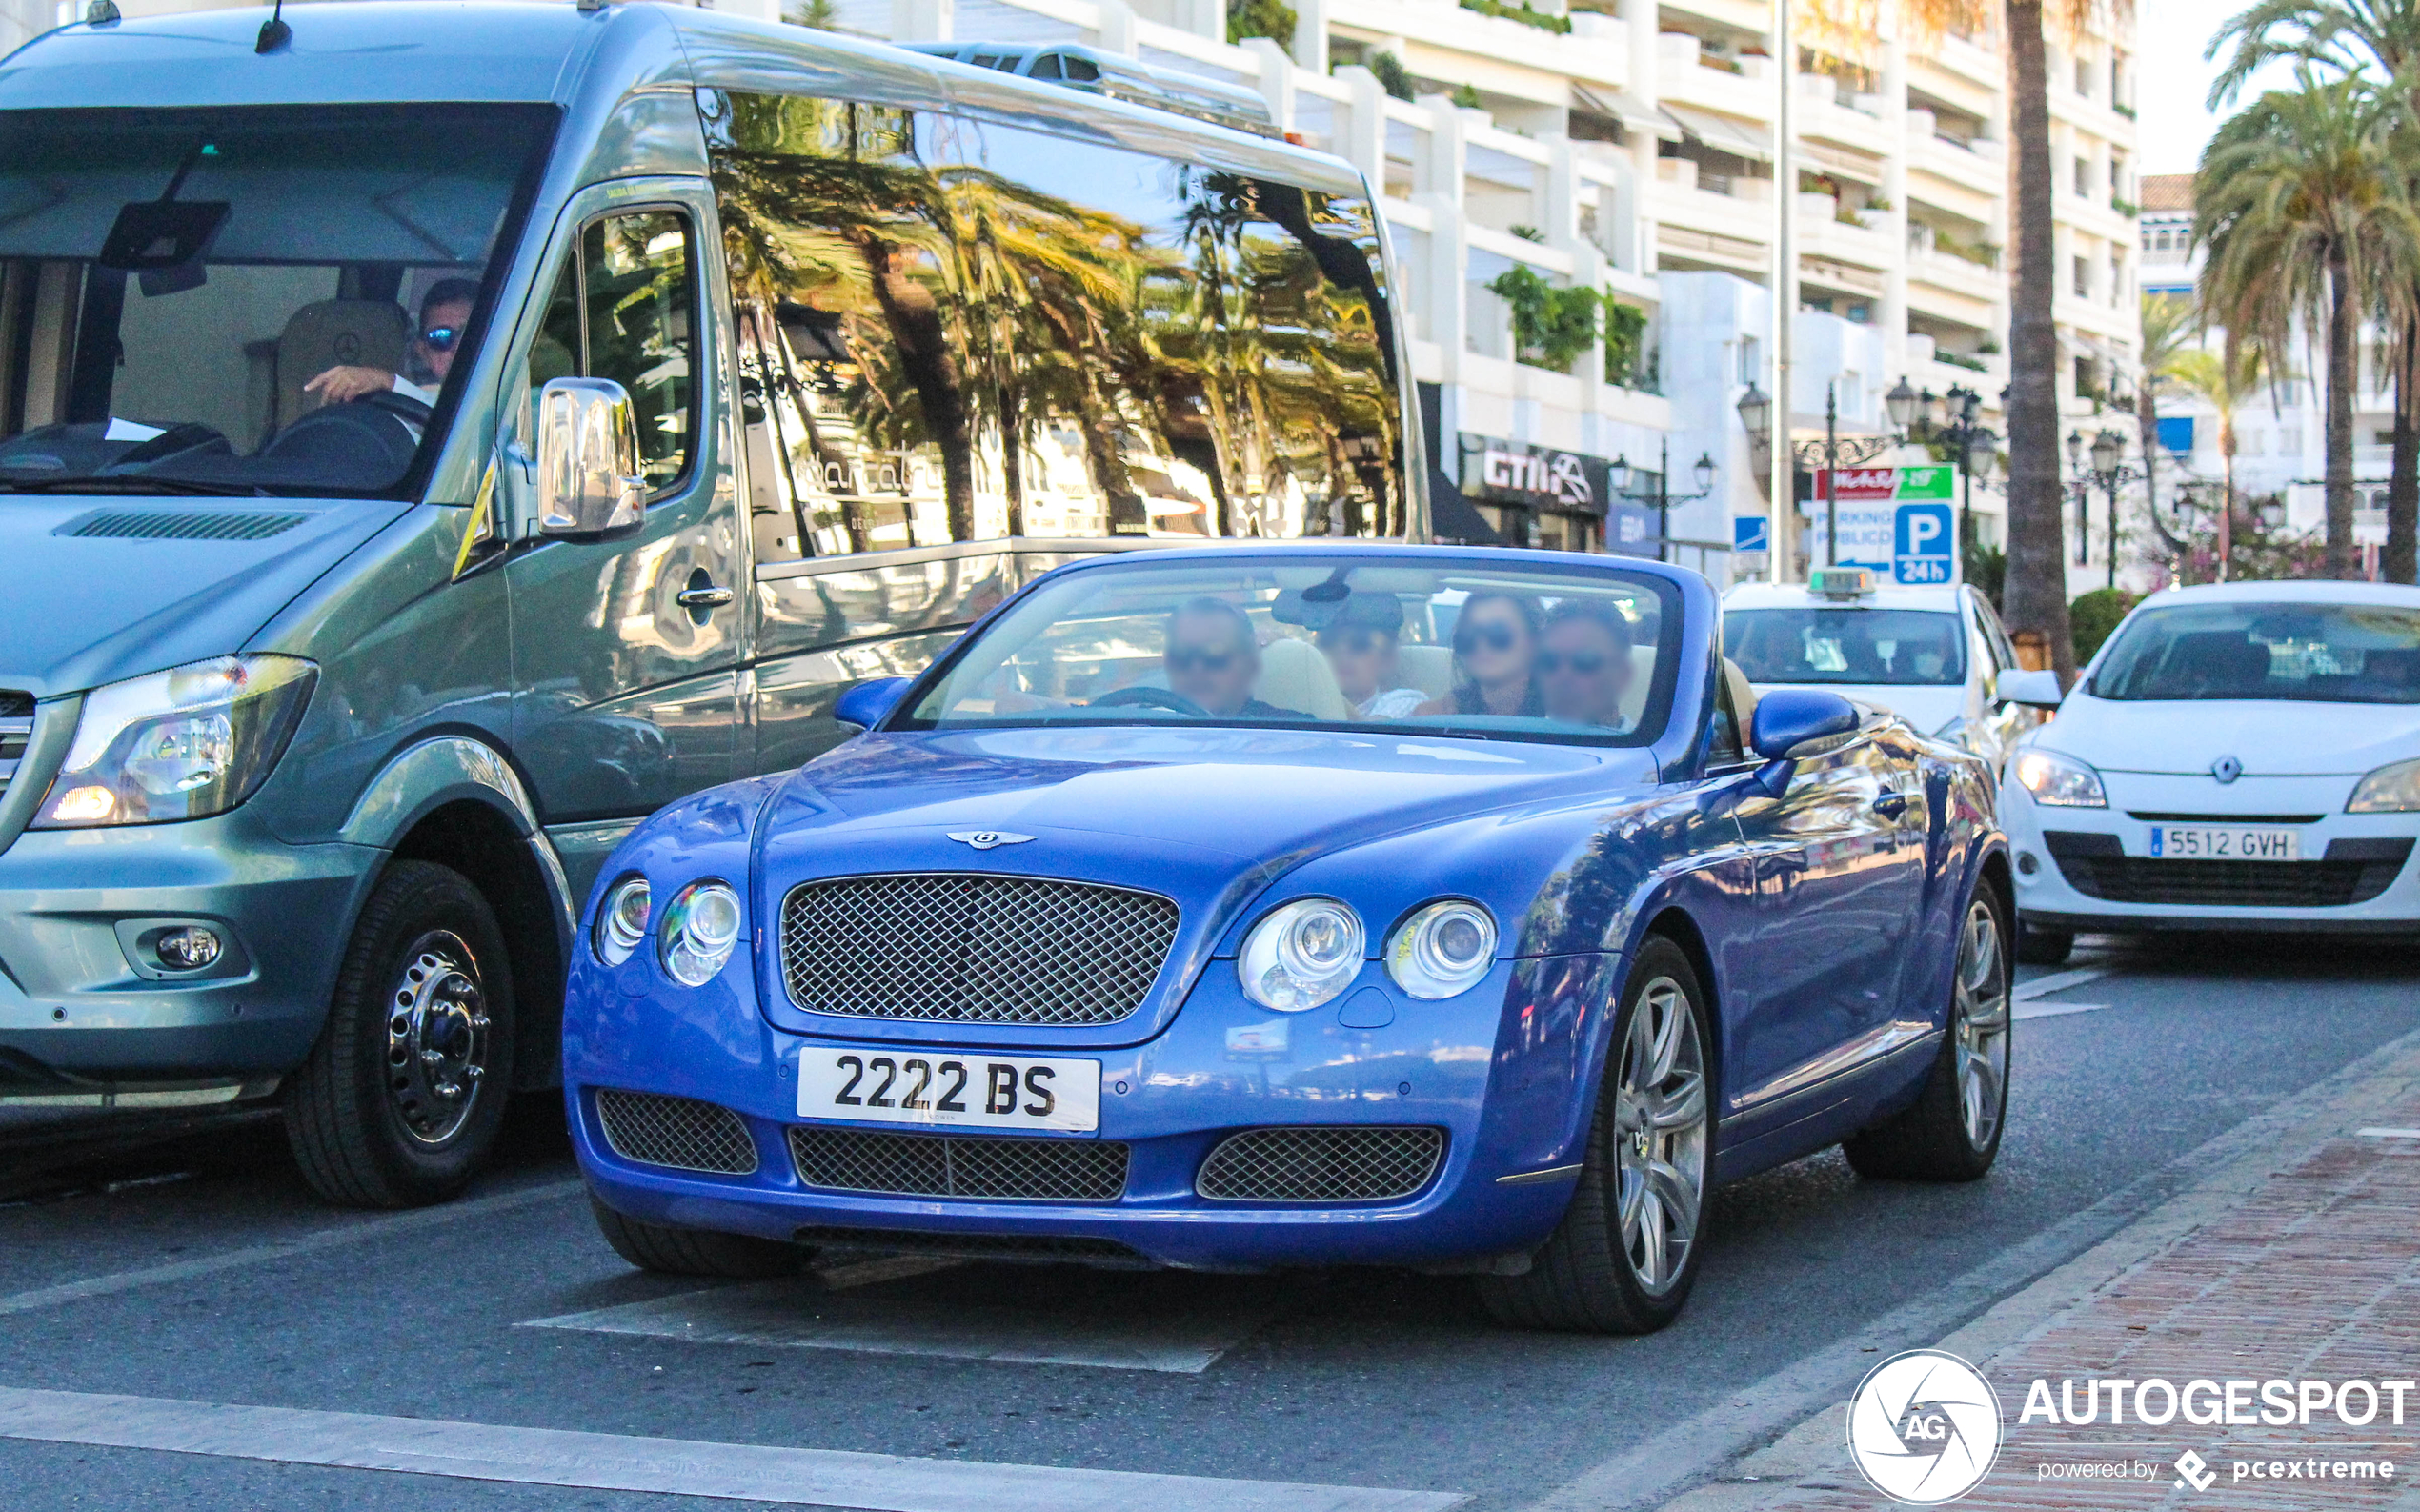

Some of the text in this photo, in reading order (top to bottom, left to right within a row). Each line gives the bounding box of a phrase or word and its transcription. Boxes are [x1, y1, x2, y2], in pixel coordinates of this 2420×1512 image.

[1816, 511, 1891, 524] PRKING
[1816, 530, 1891, 545] PBLICO
[1908, 514, 1942, 554] P
[1902, 561, 1945, 582] 24h
[2170, 831, 2288, 857] 5512 GVH
[835, 1055, 1057, 1117] 2222 BS
